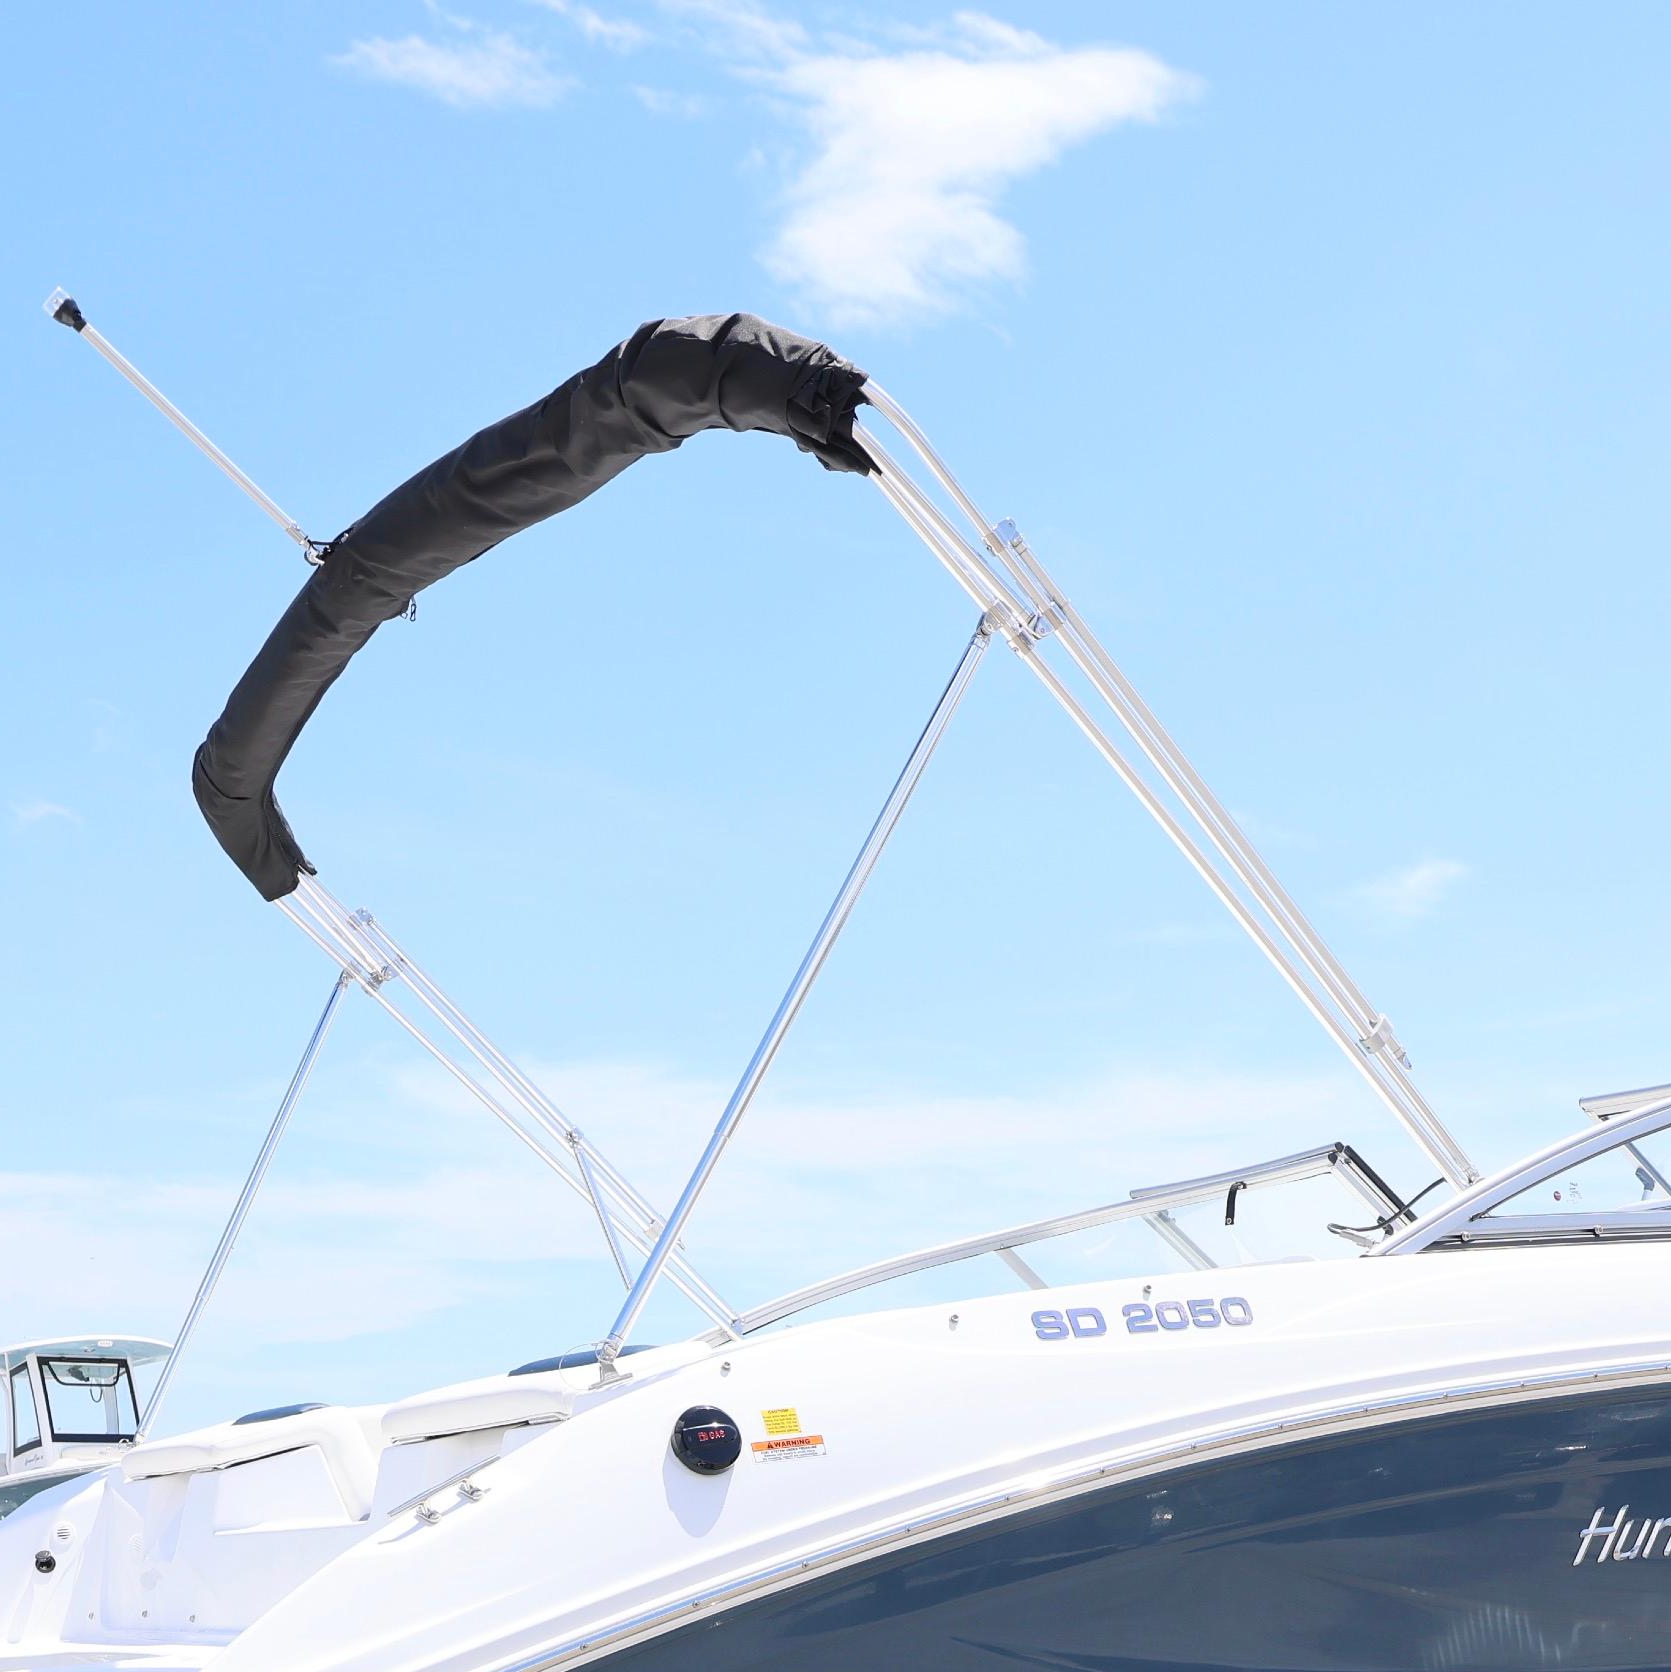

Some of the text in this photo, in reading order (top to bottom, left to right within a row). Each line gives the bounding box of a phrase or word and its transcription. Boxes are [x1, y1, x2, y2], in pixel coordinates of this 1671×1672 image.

[1030, 1296, 1254, 1340] SD 2050
[709, 1429, 726, 1440] GAS
[774, 1438, 811, 1448] WARNING
